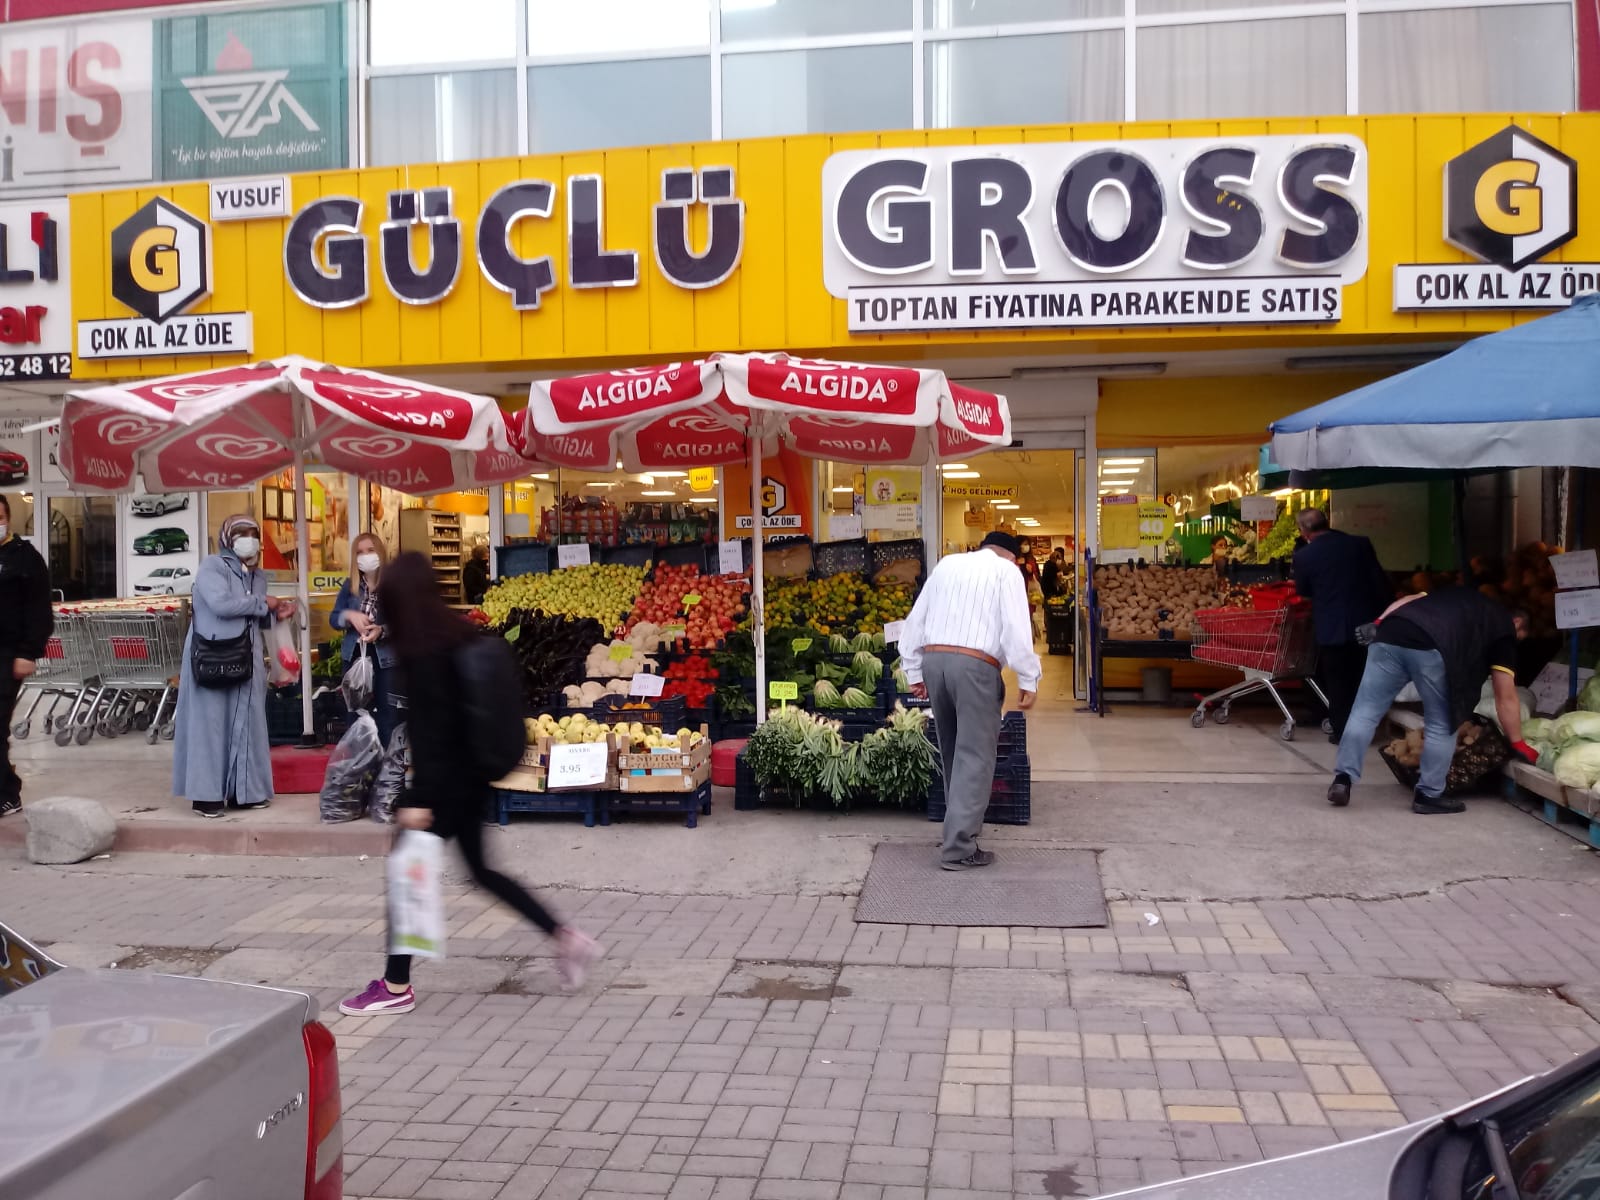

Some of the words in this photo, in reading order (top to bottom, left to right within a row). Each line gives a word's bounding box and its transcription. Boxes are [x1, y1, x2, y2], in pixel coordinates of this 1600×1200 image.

[216, 186, 281, 209] YUSUF
[832, 143, 1364, 277] GROSS
[283, 165, 746, 310] GÜÇLÜ
[1416, 272, 1469, 304] ÇOK
[1477, 272, 1509, 300] AL
[1518, 271, 1551, 299] AZ
[1560, 267, 1600, 298] ÖD
[855, 295, 959, 323] TOPTAN
[1091, 288, 1250, 317] PARAKENDE
[1261, 285, 1338, 319] SATIŞ
[91, 327, 128, 354] ÇOK
[134, 324, 157, 348] AL
[164, 324, 188, 347] AZ
[194, 318, 233, 345] ÖDE
[20, 356, 43, 375] 48
[49, 355, 71, 374] 12
[769, 517, 779, 526] AZ
[781, 515, 796, 526] ÖDE
[1140, 519, 1164, 535] 40
